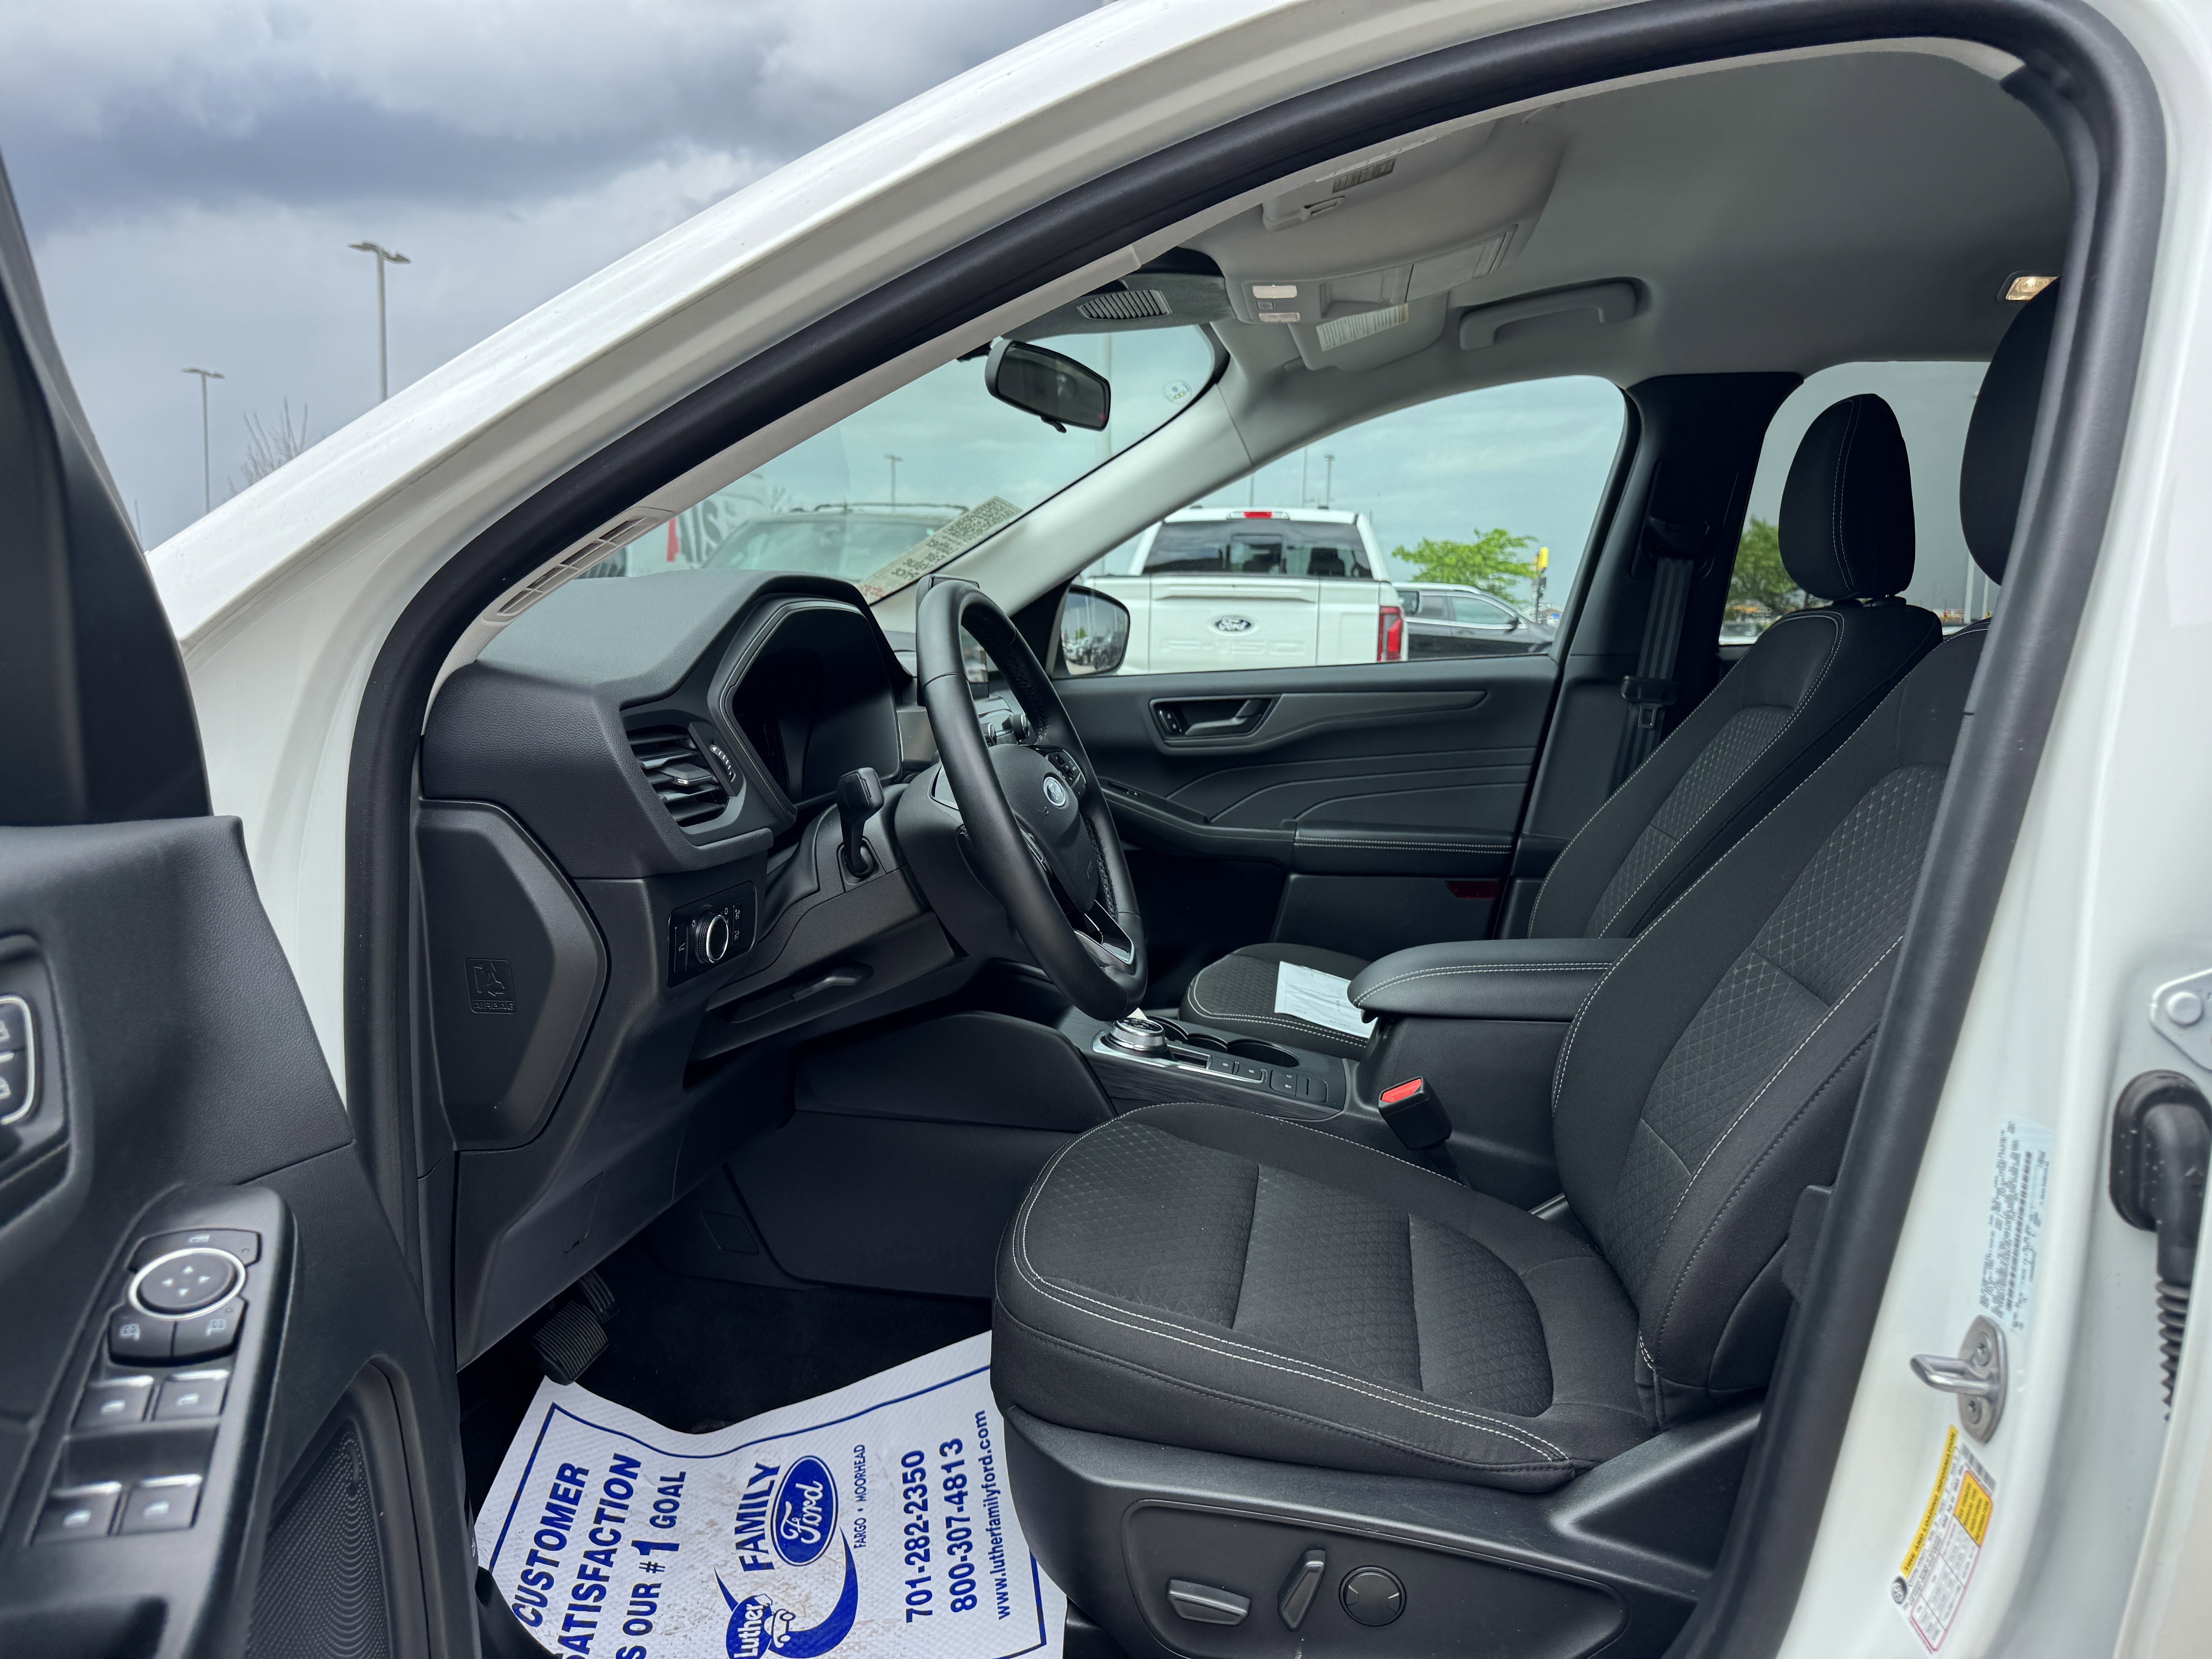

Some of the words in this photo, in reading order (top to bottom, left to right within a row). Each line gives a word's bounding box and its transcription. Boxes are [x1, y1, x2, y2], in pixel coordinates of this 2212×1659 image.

[473, 1001, 515, 1011] AIRBAG
[649, 1471, 686, 1529] GOAL
[854, 1444, 867, 1503] MOORHEAD
[1914, 1532, 1924, 1551] AND
[1922, 1494, 1939, 1532] LOADING
[1937, 1431, 1956, 1493] INFORMATION
[735, 1462, 781, 1572] FAMILY
[780, 1483, 823, 1544] Ford
[854, 1517, 867, 1549] FARGO
[901, 1449, 933, 1623] 701-282-2350
[939, 1437, 977, 1613] 800-307-4813
[975, 1409, 1011, 1620] www.lutherfamilyford.com
[511, 1462, 589, 1627] CUSTOMER
[557, 1453, 641, 1659] ATISFACTION
[630, 1540, 680, 1574] #1
[622, 1582, 662, 1636] OUR
[733, 1603, 764, 1658] Luther
